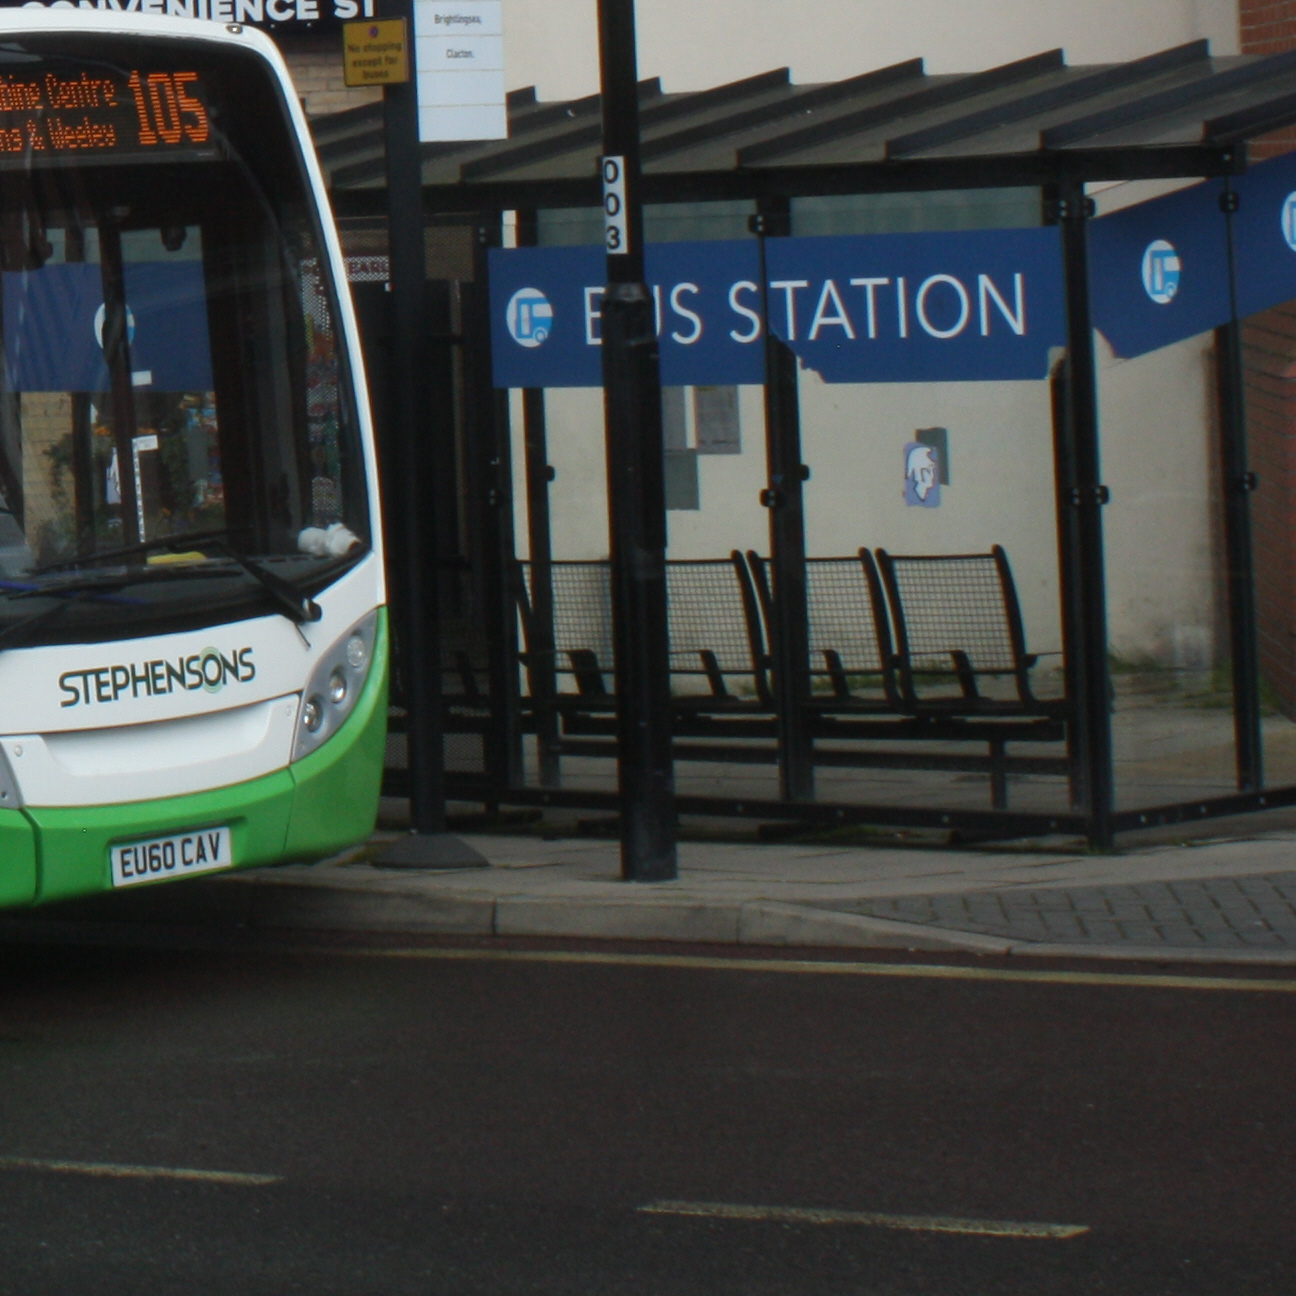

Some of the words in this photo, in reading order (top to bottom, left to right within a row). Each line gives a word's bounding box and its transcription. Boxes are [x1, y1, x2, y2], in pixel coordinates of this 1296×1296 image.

[46, 72, 118, 109] Centre
[128, 70, 208, 145] 105
[584, 282, 702, 346] BS
[729, 273, 1026, 345] STATION
[59, 647, 256, 707] STEPHENSONS
[120, 841, 176, 878] EU60
[181, 832, 220, 866] CAV
